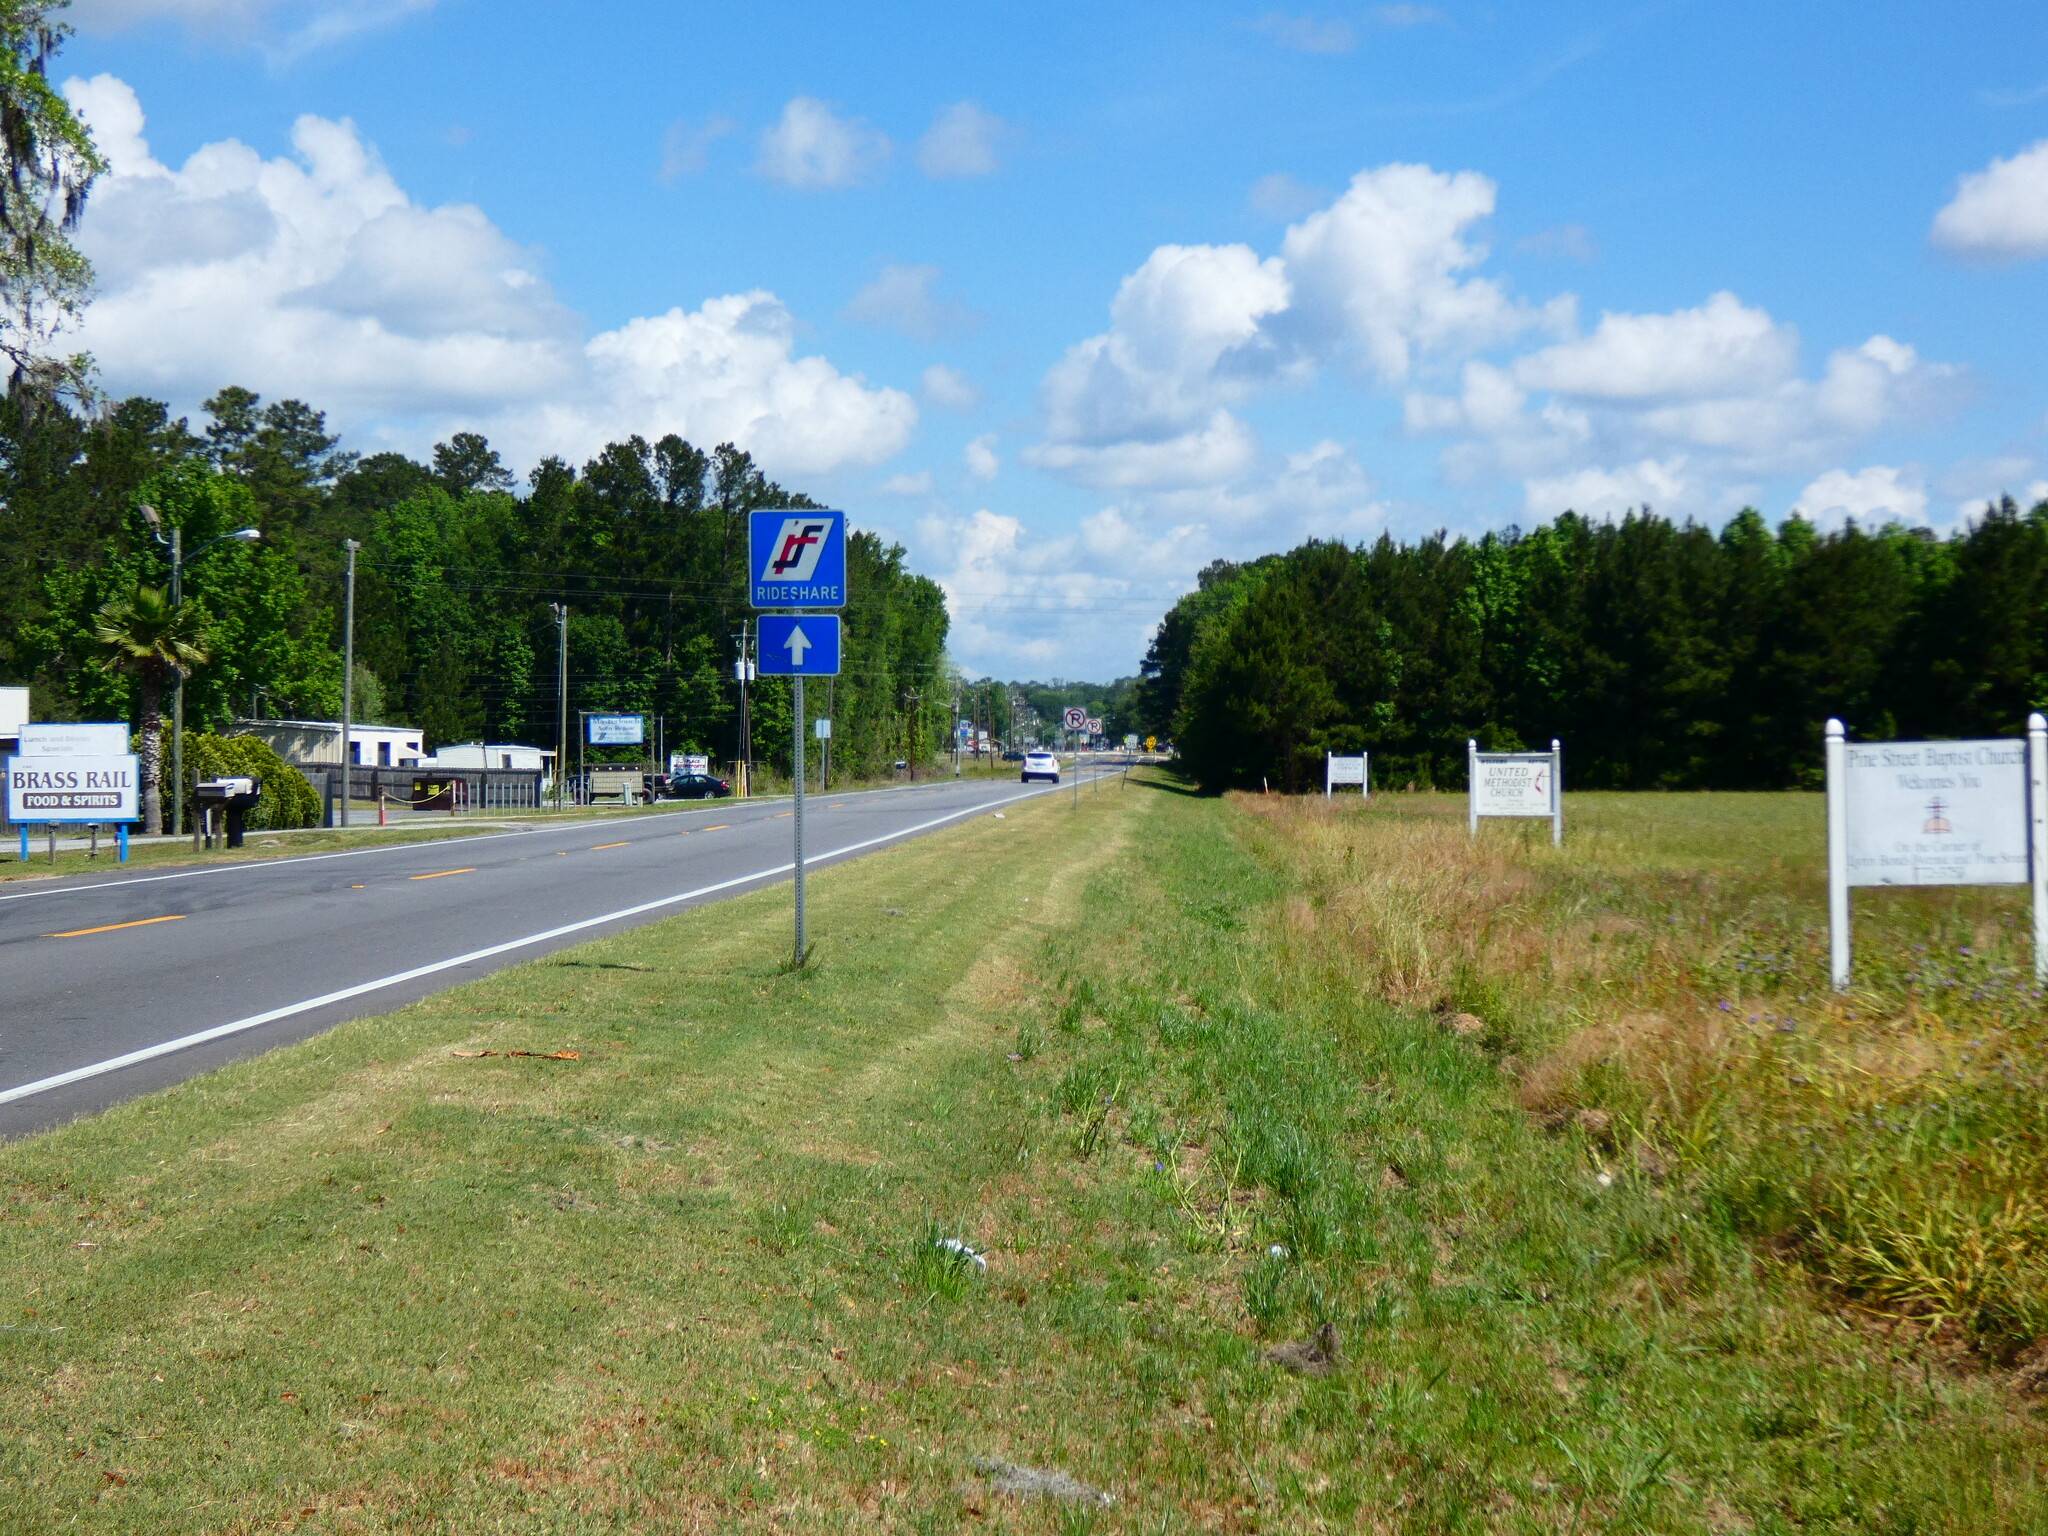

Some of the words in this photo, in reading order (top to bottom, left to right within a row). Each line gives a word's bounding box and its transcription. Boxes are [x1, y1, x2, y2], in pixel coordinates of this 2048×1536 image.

[757, 586, 839, 600] RIDESHARE
[23, 735, 47, 743] Lunch
[1847, 750, 1877, 768] Pine
[1881, 749, 1920, 767] Street
[1925, 748, 1972, 770] Baptist
[1489, 767, 1528, 777] UNITED
[13, 771, 78, 789] BRASS
[86, 771, 131, 788] RAIL
[1484, 777, 1532, 788] METHODIST
[1897, 774, 1956, 790] Welcomes
[1958, 773, 1981, 789] You
[1490, 787, 1524, 797] CHURCH
[26, 795, 59, 807] FOOD
[61, 795, 72, 806] &
[73, 794, 118, 806] SPIRITS
